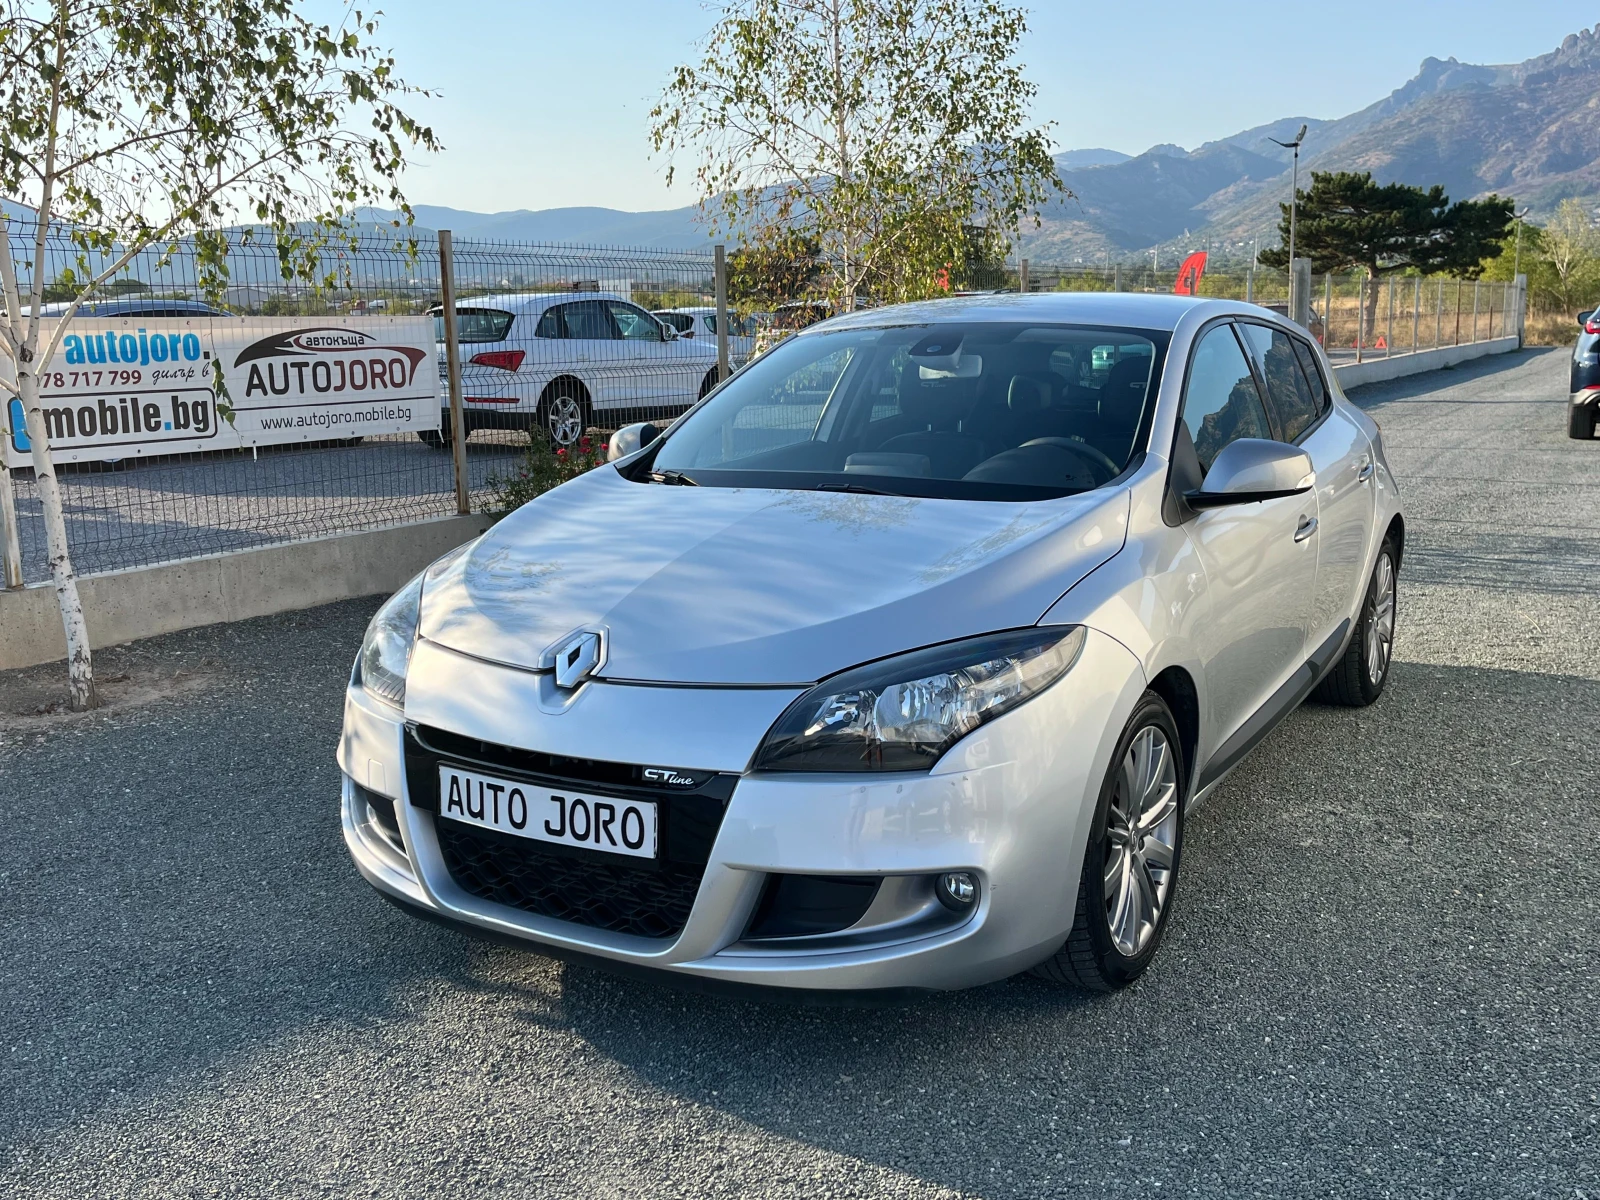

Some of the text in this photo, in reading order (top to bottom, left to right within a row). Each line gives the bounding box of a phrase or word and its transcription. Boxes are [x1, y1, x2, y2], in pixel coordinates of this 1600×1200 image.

[63, 328, 210, 366] autojoro.
[305, 334, 365, 347] автокъща
[69, 371, 103, 387] 717
[108, 370, 142, 385] 799
[152, 366, 195, 385] дилър
[245, 358, 407, 397] AUTOJORO
[42, 396, 210, 438] mobile.bg
[261, 405, 412, 430] www.autojoro.mobile.bg
[447, 774, 645, 850] AUTO JORO
